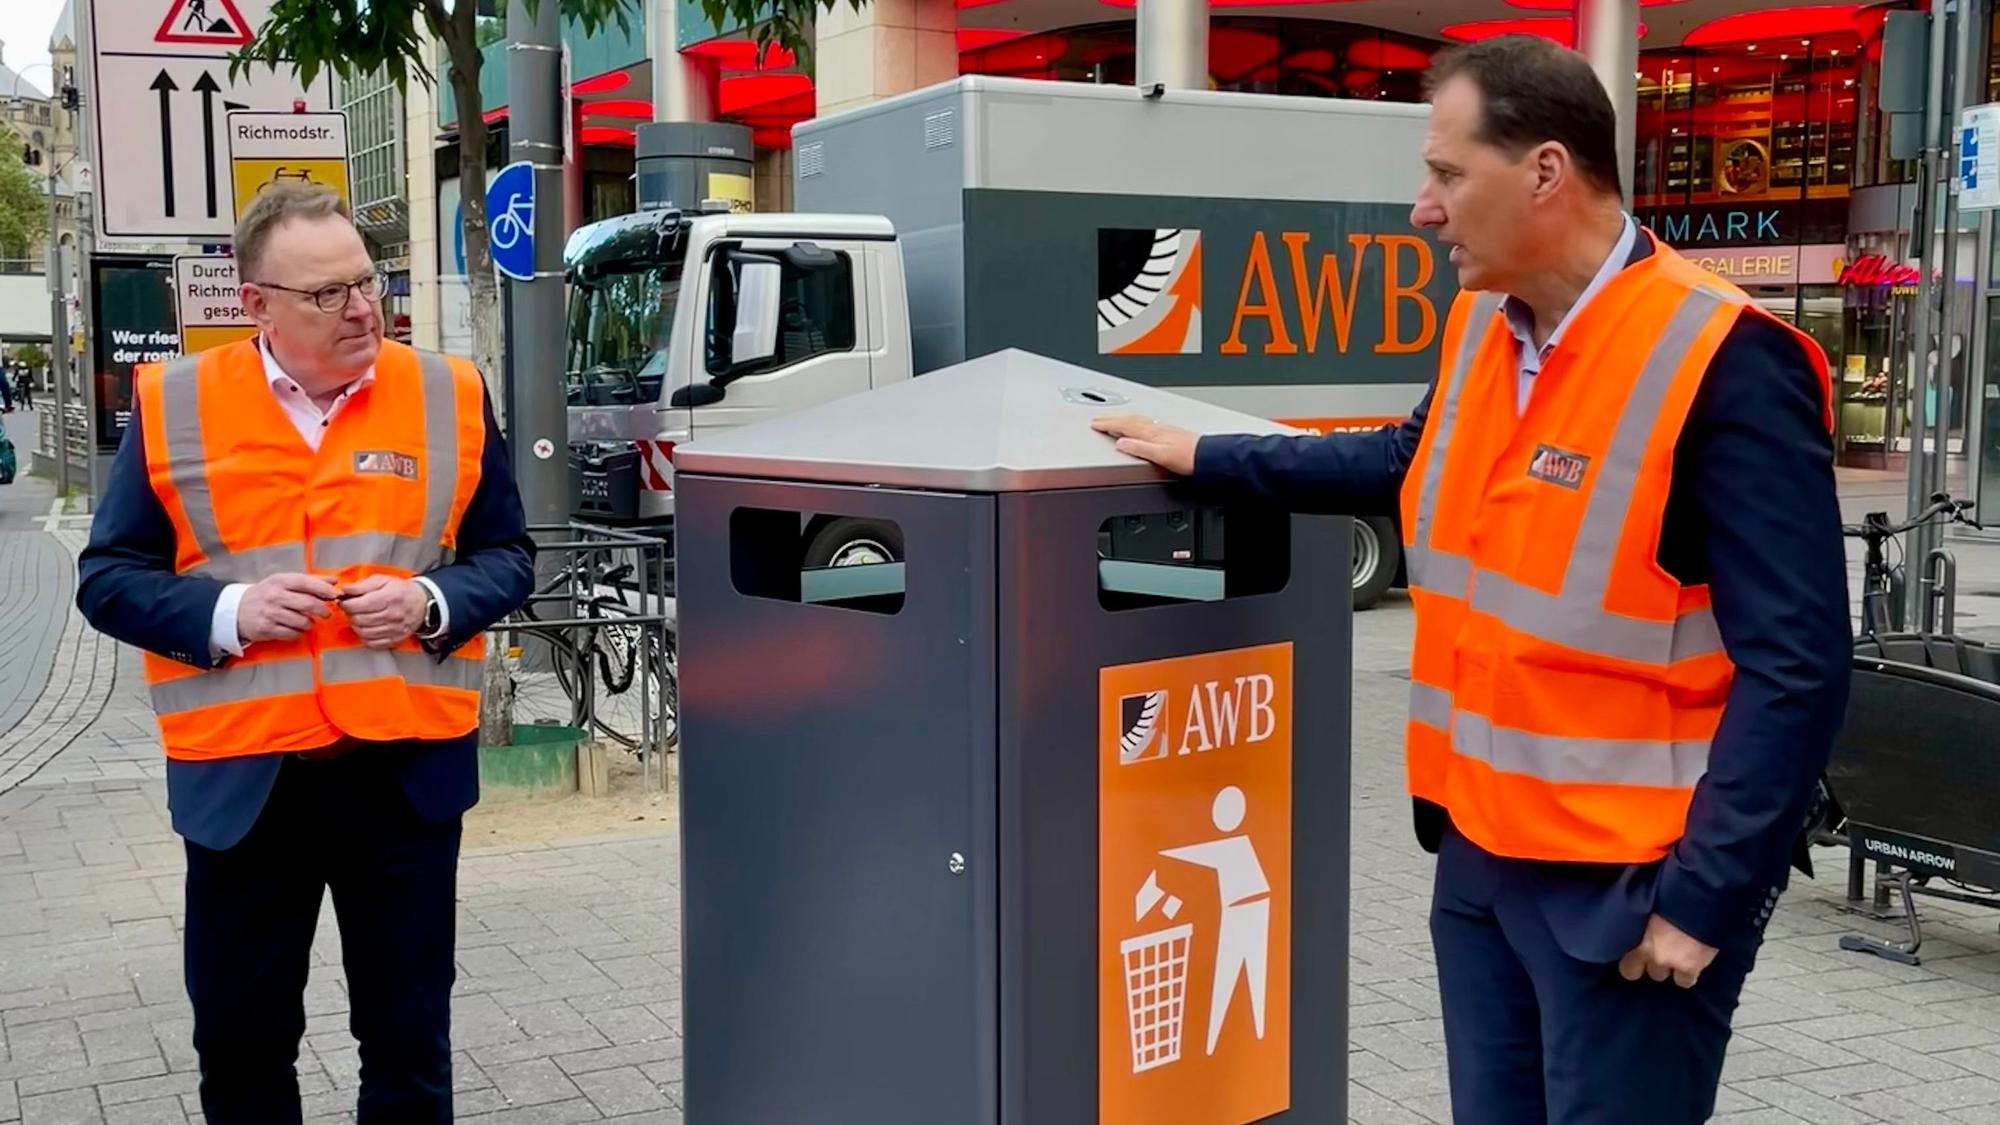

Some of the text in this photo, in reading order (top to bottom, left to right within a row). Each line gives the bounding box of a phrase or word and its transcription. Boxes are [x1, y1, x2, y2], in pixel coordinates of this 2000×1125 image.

[238, 125, 335, 140] Richmodstr.
[1634, 209, 1781, 242] IMARK
[1692, 254, 1791, 276] GALERIE
[1220, 230, 1438, 355] AWB
[112, 330, 146, 345] Wer
[113, 348, 142, 363] der
[1540, 451, 1583, 483] AWB
[1178, 673, 1276, 756] AWB
[1864, 838, 1955, 871] URBAN ARROW
